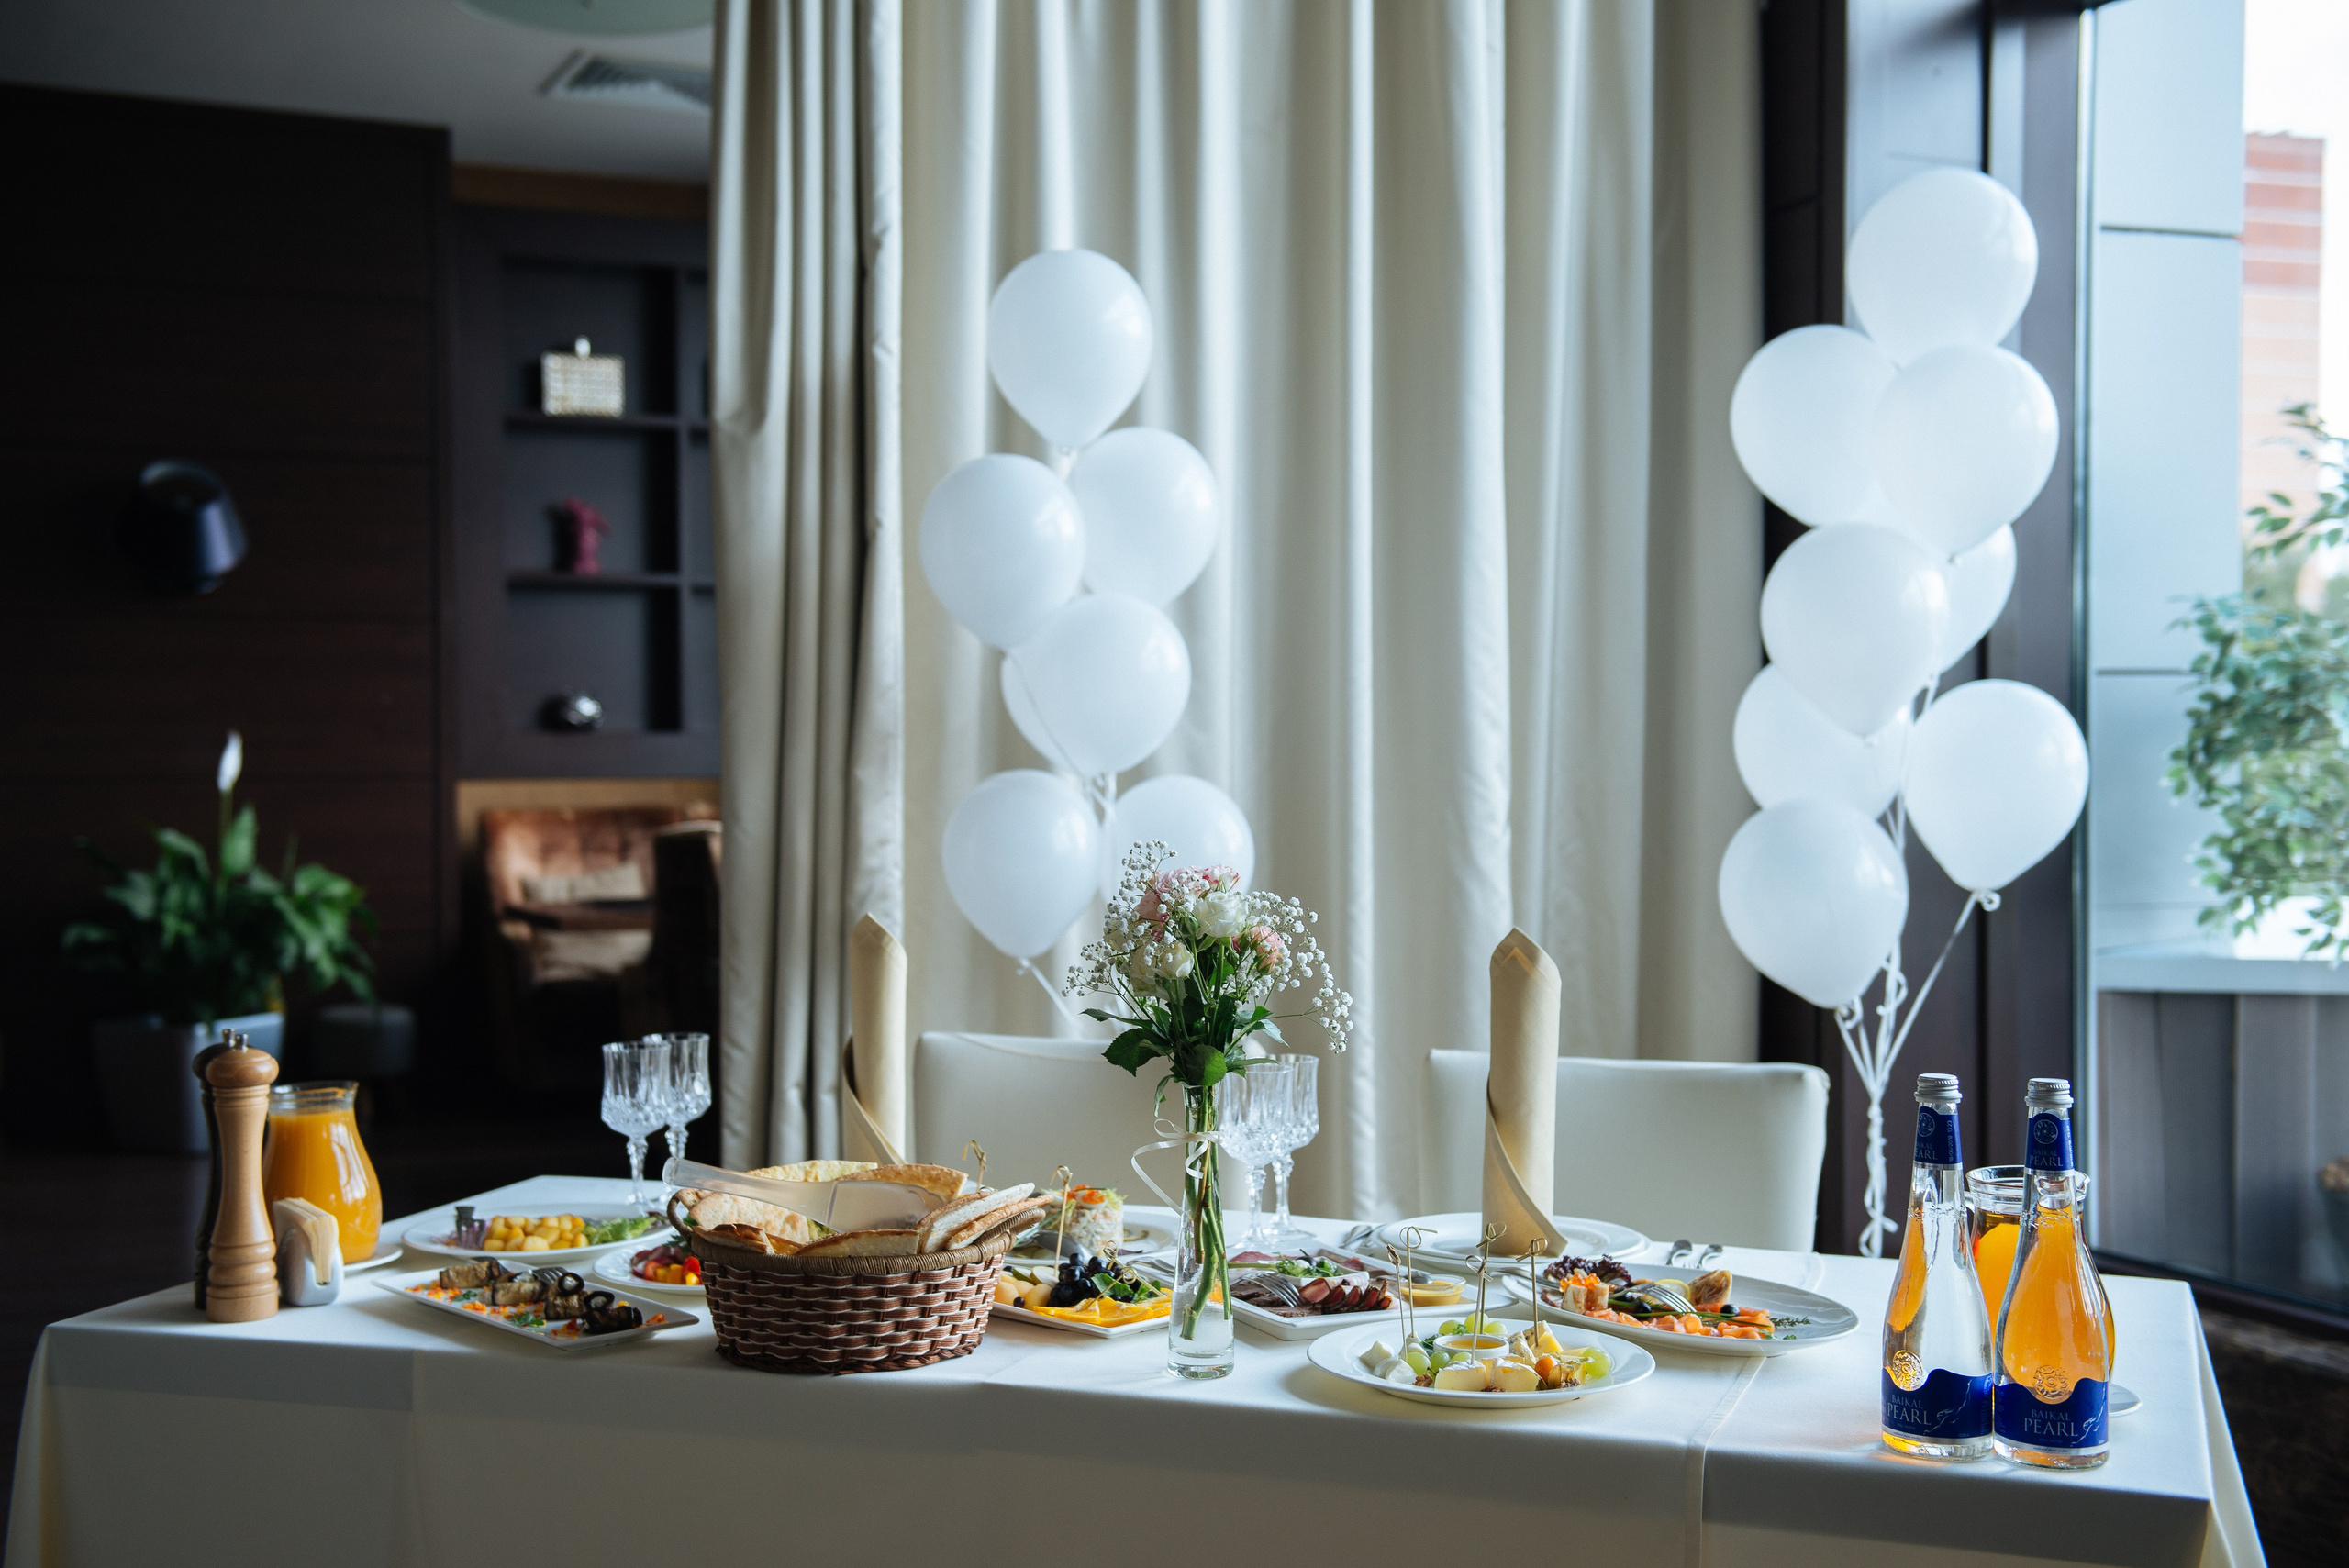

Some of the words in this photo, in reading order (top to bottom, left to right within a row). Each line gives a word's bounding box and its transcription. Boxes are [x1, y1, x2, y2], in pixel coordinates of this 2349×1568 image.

[1915, 1147, 1939, 1161] EARL
[2029, 1154, 2064, 1167] PEARL
[1891, 1394, 1924, 1409] BAIKAL
[1887, 1402, 1932, 1426] PEARL
[2031, 1408, 2071, 1421] BAIKAL
[2023, 1417, 2079, 1437] PEARL
